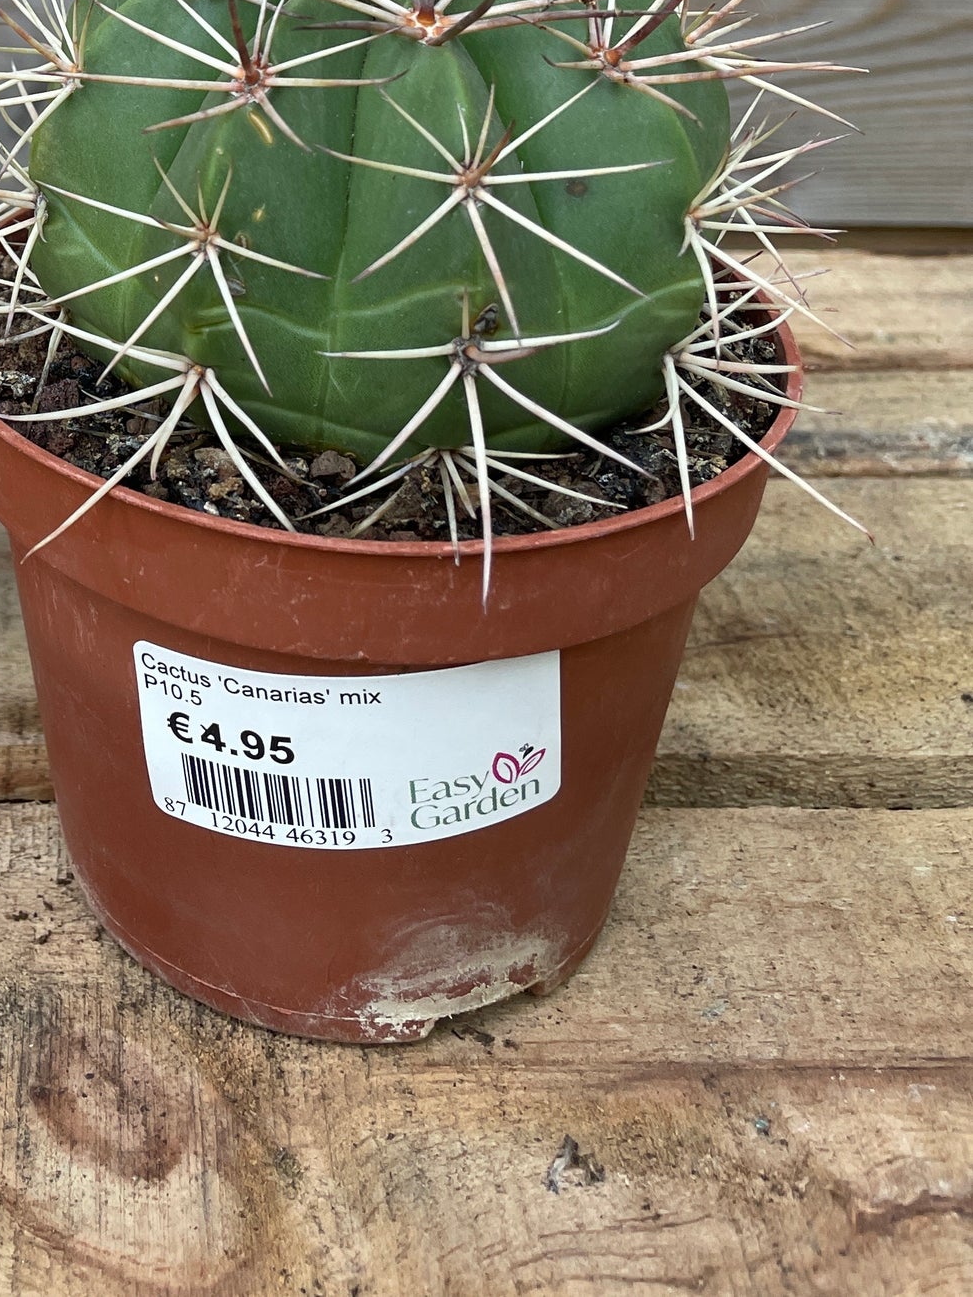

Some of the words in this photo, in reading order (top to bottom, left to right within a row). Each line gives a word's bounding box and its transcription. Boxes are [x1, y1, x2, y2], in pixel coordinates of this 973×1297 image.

[141, 653, 211, 688] Cactus
[218, 676, 330, 705] 'Canarias'
[340, 689, 381, 704] mix
[145, 675, 202, 706] P10.5
[409, 770, 490, 804] Easy
[411, 775, 540, 830] Garden
[165, 798, 186, 817] 87
[212, 813, 275, 840] 12044
[286, 829, 356, 846] 46319
[382, 828, 392, 844] 3
